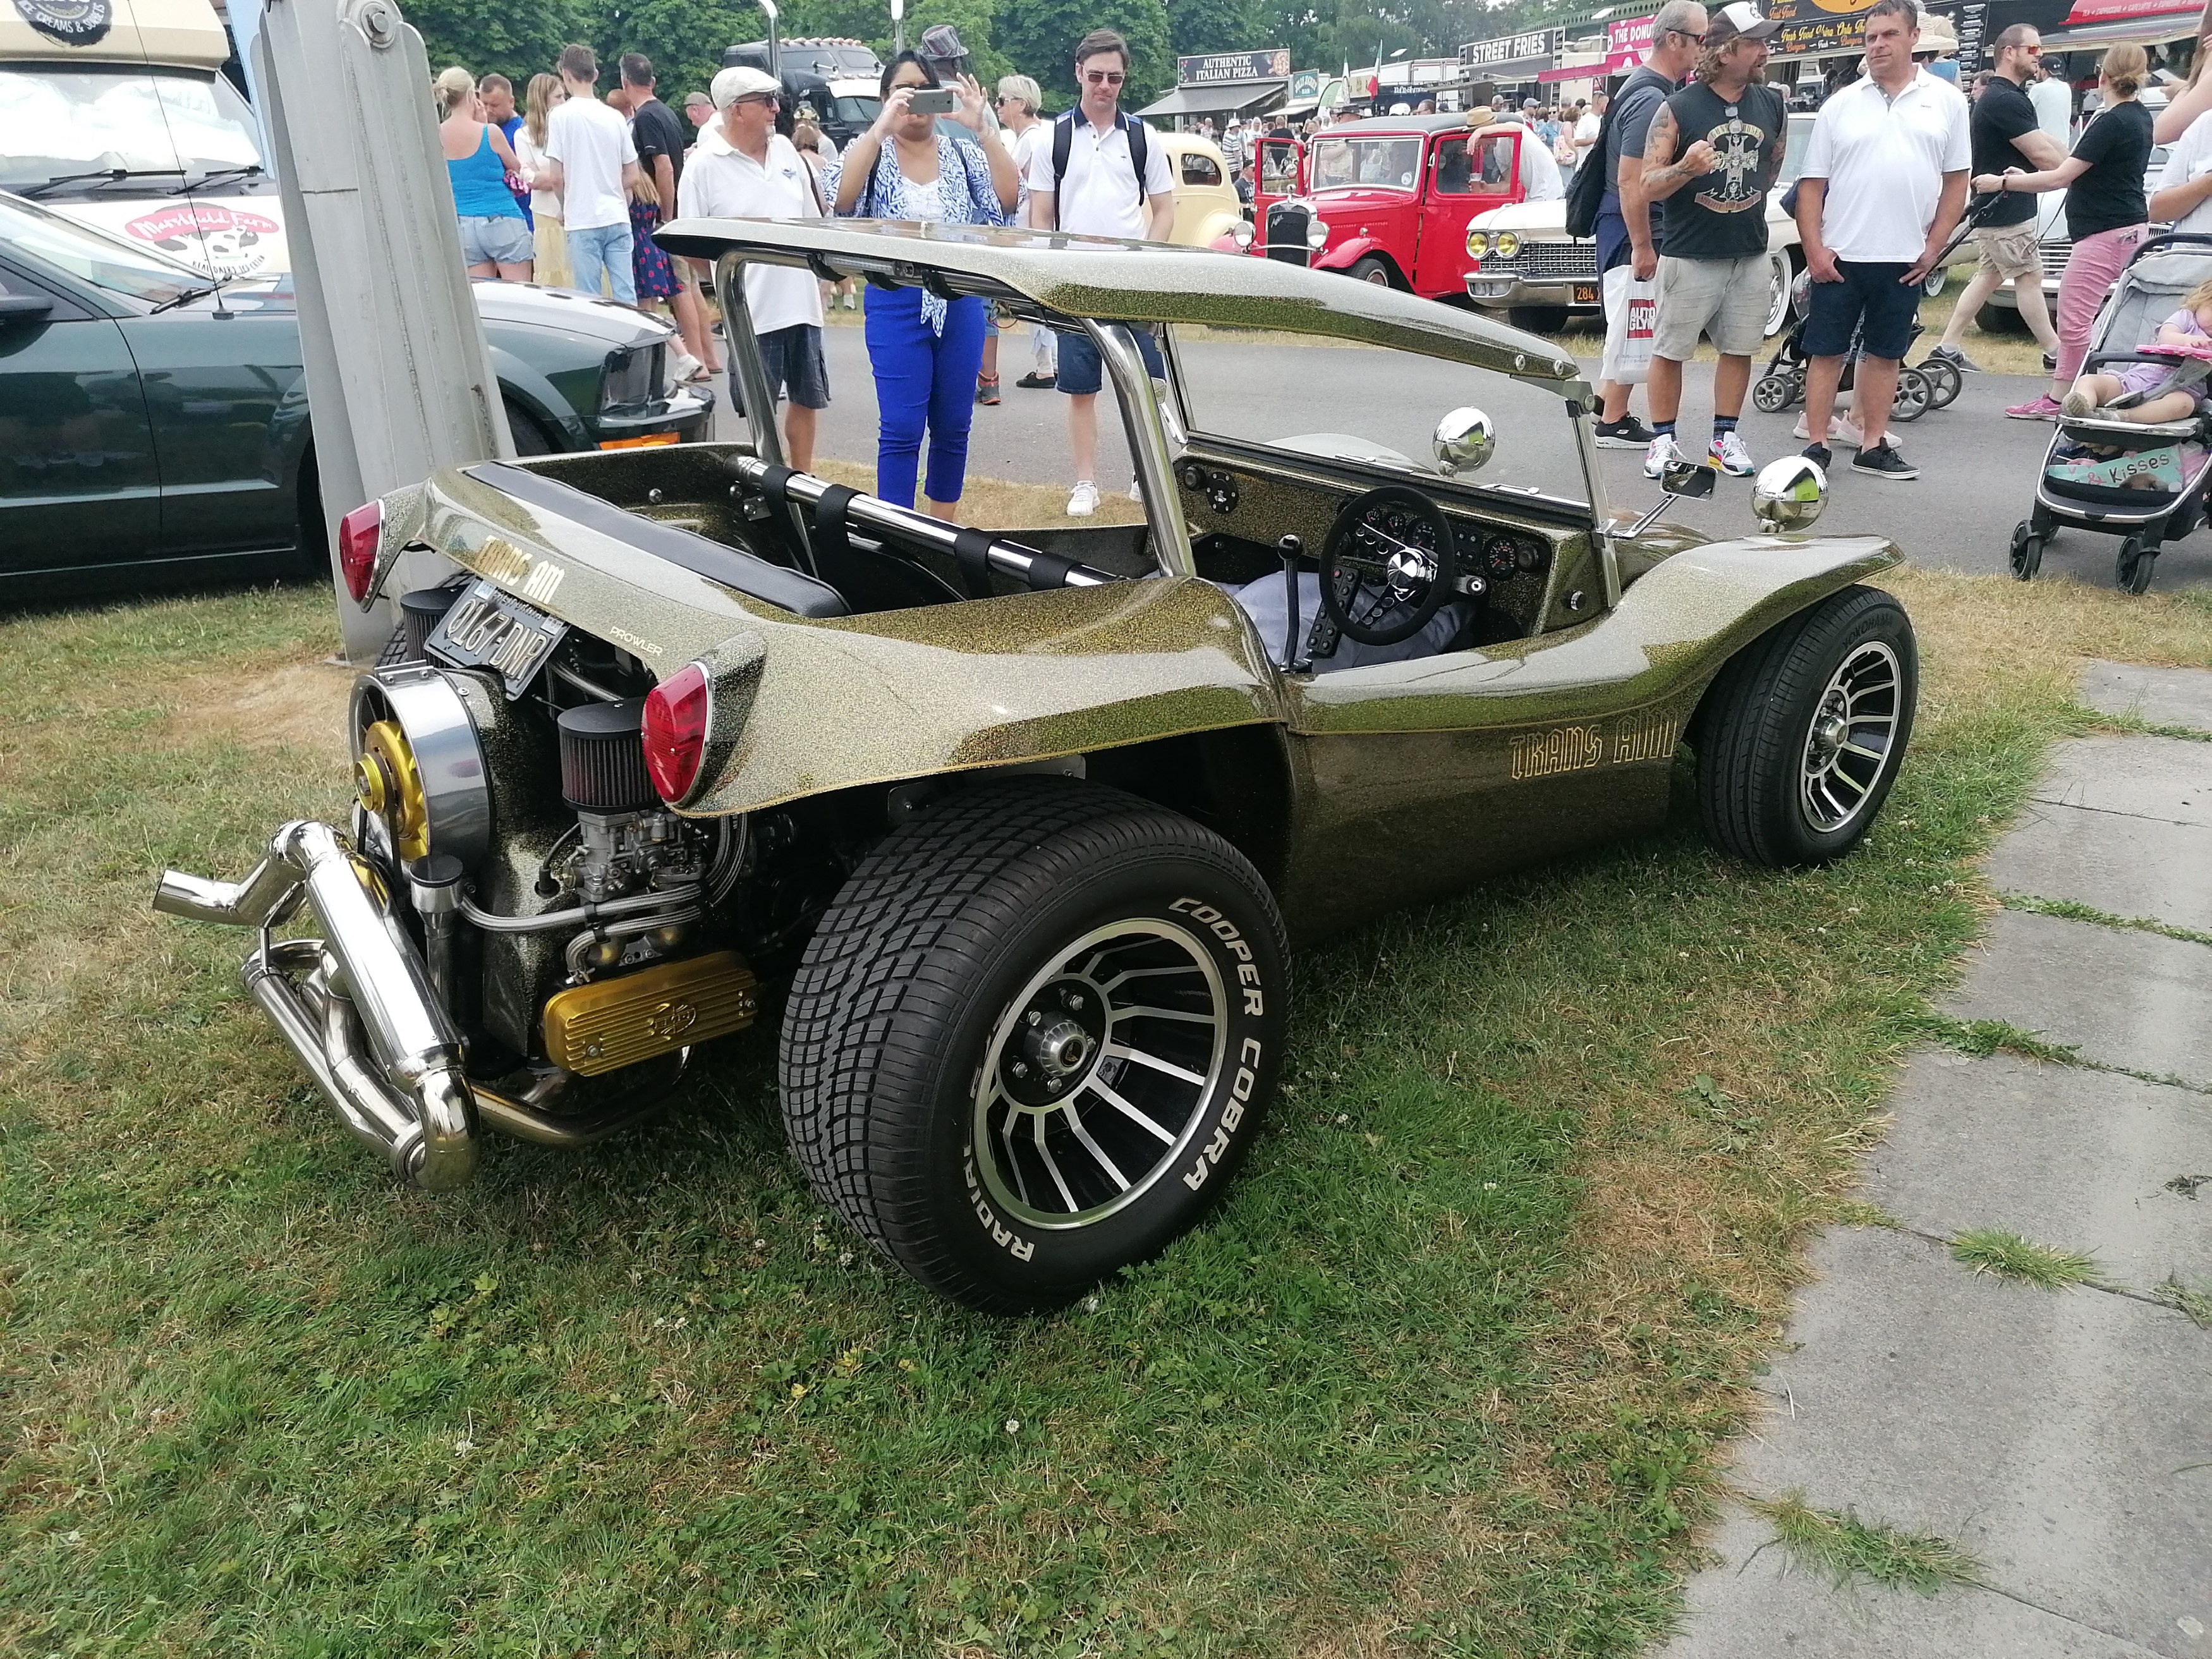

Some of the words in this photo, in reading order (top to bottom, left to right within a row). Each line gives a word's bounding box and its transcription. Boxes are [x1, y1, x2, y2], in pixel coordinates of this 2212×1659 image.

[36, 12, 74, 33] CREAMS
[75, 22, 85, 32] &
[1615, 27, 1629, 44] THE
[1781, 28, 1797, 42] Fresh
[1799, 26, 1815, 40] Food
[1473, 39, 1511, 63] STREET
[1513, 33, 1545, 58] FRIES
[1203, 56, 1252, 69] AUTHENTIC
[1196, 68, 1231, 81] ITALIAN
[1232, 66, 1258, 78] PIZZA
[229, 211, 273, 228] Farm
[1577, 286, 1594, 300] 284
[1631, 307, 1656, 319] AUTO
[2087, 471, 2107, 485] &
[2108, 453, 2170, 483] Kisses
[474, 535, 533, 586] TRANS
[523, 561, 565, 605] AM
[610, 626, 663, 656] PROWLER
[1509, 724, 1603, 780] TRANS
[1613, 707, 1678, 763] AM
[1168, 897, 1264, 1017] COOPER
[1182, 1037, 1262, 1191] COBRA
